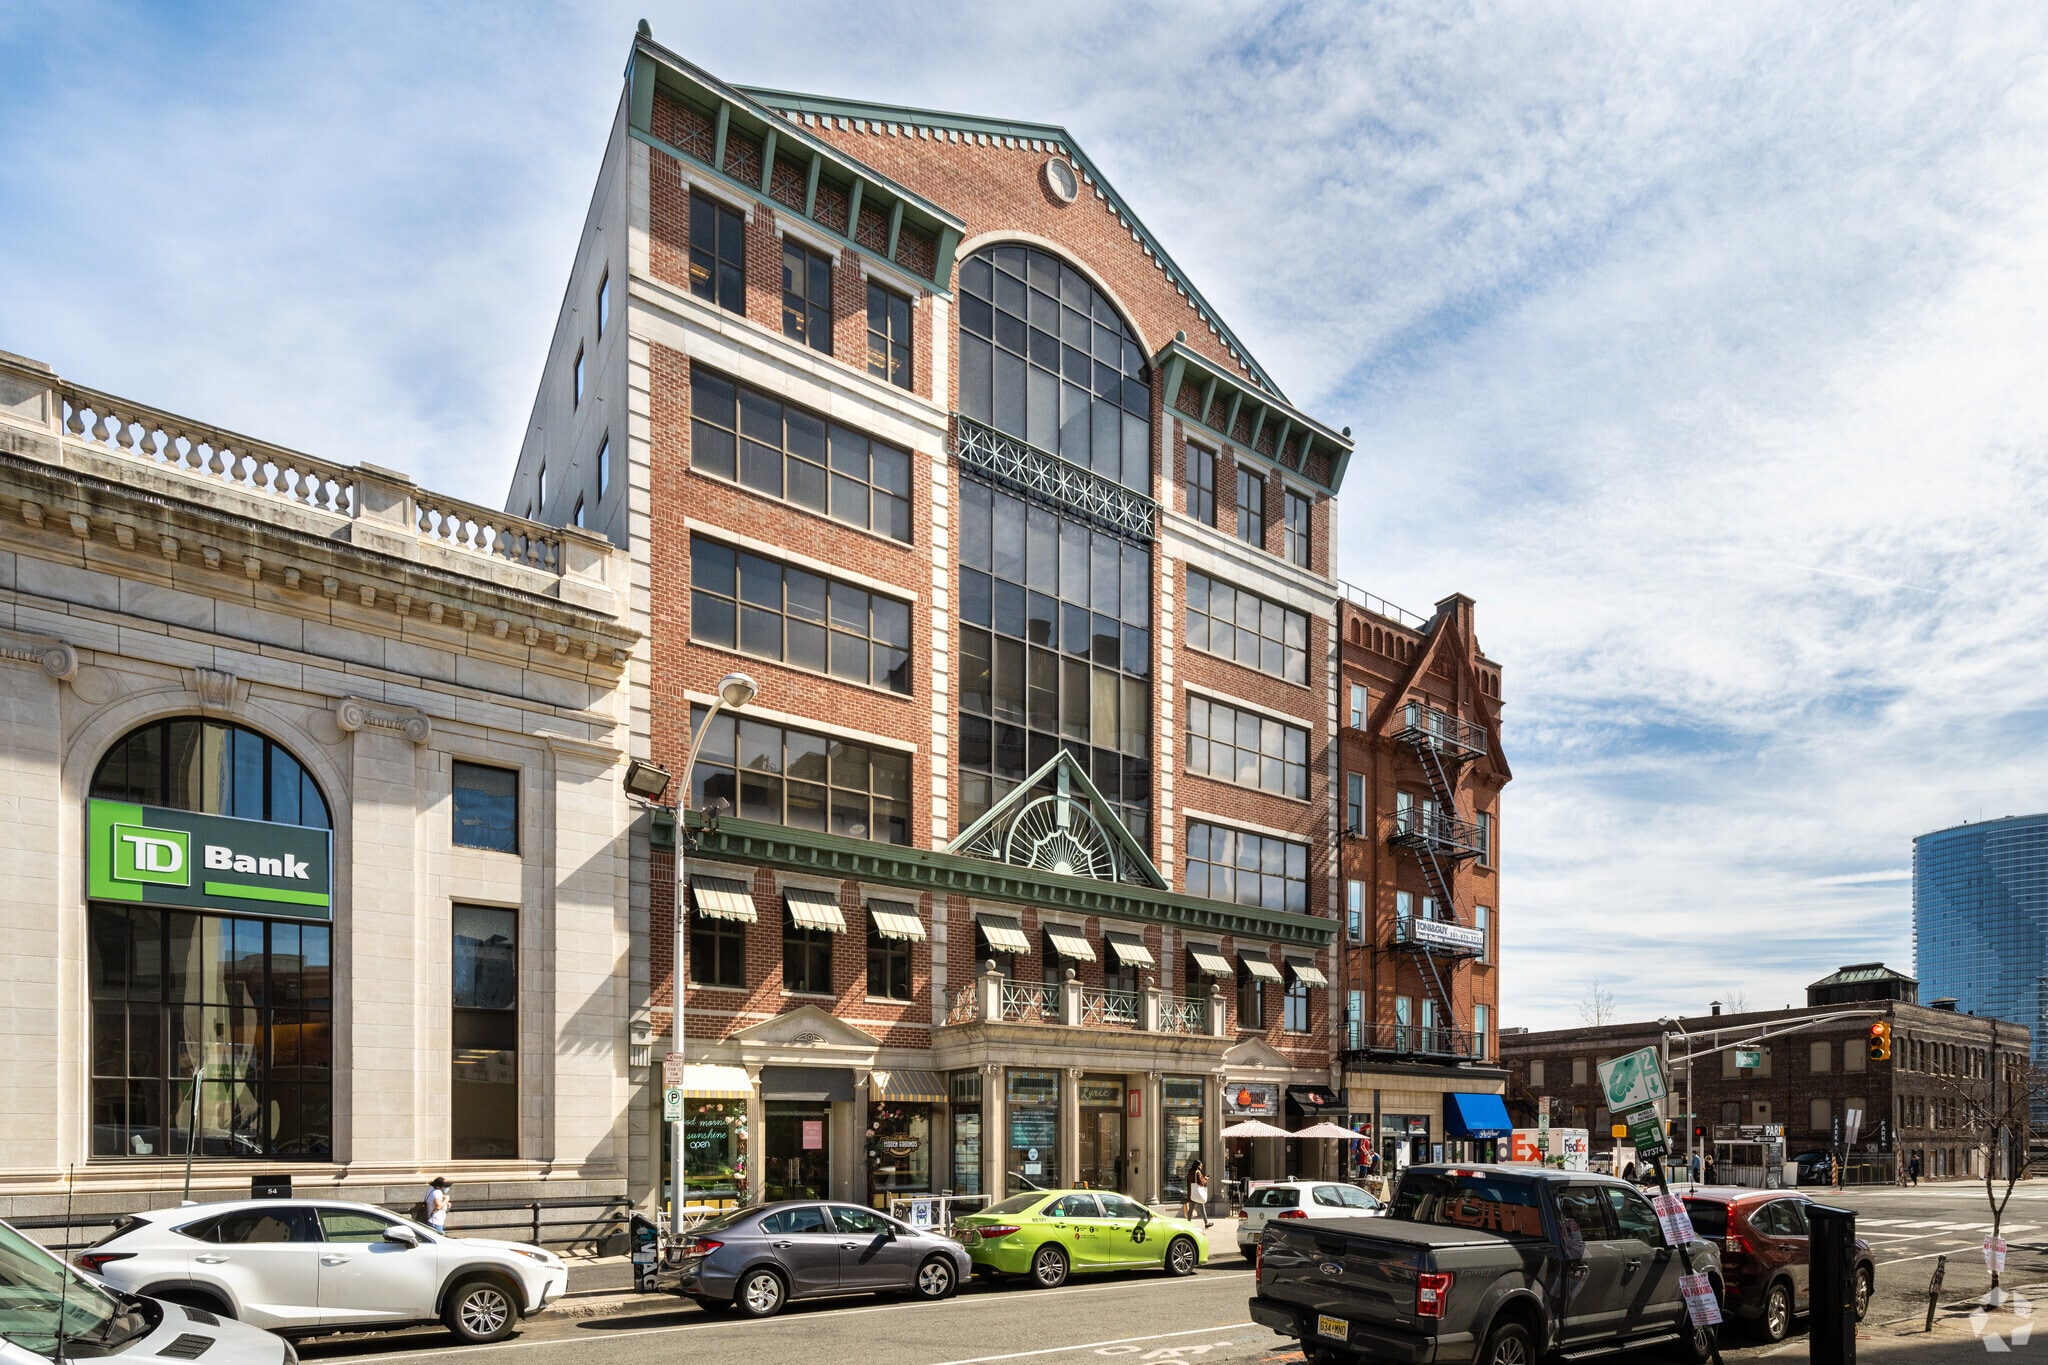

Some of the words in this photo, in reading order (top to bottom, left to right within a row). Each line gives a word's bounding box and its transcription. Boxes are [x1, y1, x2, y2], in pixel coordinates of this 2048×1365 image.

[123, 835, 182, 873] TD
[205, 845, 309, 879] Bank
[1416, 921, 1448, 935] TONI&GUY
[1642, 1052, 1653, 1070] 2
[671, 1093, 677, 1102] P
[1081, 1087, 1109, 1099] Lyric
[686, 1128, 727, 1139] sunshine
[690, 1141, 710, 1149] open
[1564, 1138, 1586, 1152] FedEx
[1642, 1146, 1664, 1158] 47374
[1656, 1207, 1666, 1217] NO
[1665, 1204, 1686, 1216] PARKING
[1461, 1268, 1492, 1276] SPORT
[1683, 1288, 1691, 1297] NO
[1690, 1285, 1712, 1297] PARKING
